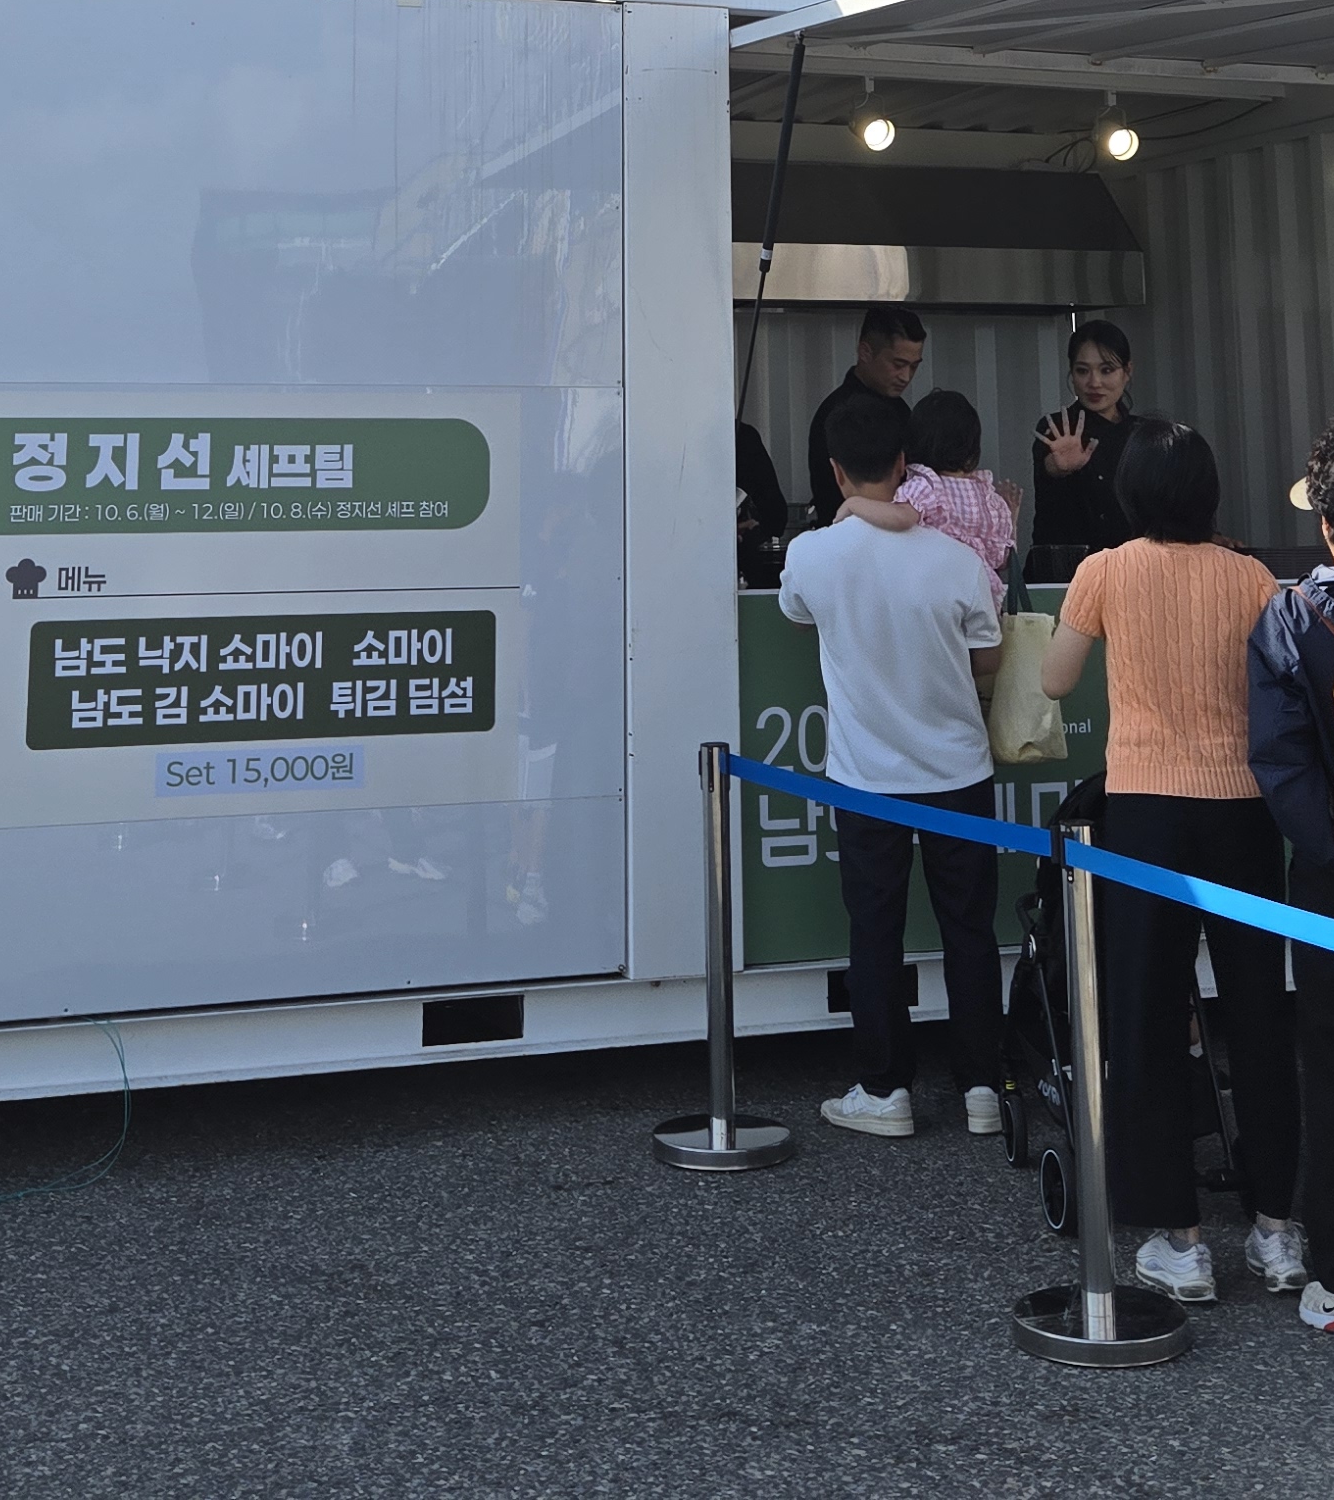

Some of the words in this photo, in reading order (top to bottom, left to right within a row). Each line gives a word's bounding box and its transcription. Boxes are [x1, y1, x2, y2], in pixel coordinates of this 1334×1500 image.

[226, 444, 354, 489] 셰프팀
[9, 504, 43, 523] 판매
[192, 503, 245, 522] 12.(일)
[336, 501, 382, 519] 정지선
[384, 501, 416, 519] 셰프
[418, 501, 449, 519] 참여
[57, 566, 107, 592] 메뉴
[54, 637, 127, 678] 남도
[137, 634, 208, 674] 낙지
[218, 631, 324, 671] 쇼마이
[352, 627, 453, 667] 쇼마이
[71, 688, 144, 729] 남도
[154, 686, 189, 725] 김
[198, 682, 305, 723] 쇼마이
[329, 678, 398, 718] 튀김
[408, 676, 474, 715] 딤섬
[165, 759, 216, 787] Set
[225, 752, 356, 788] 15,000원
